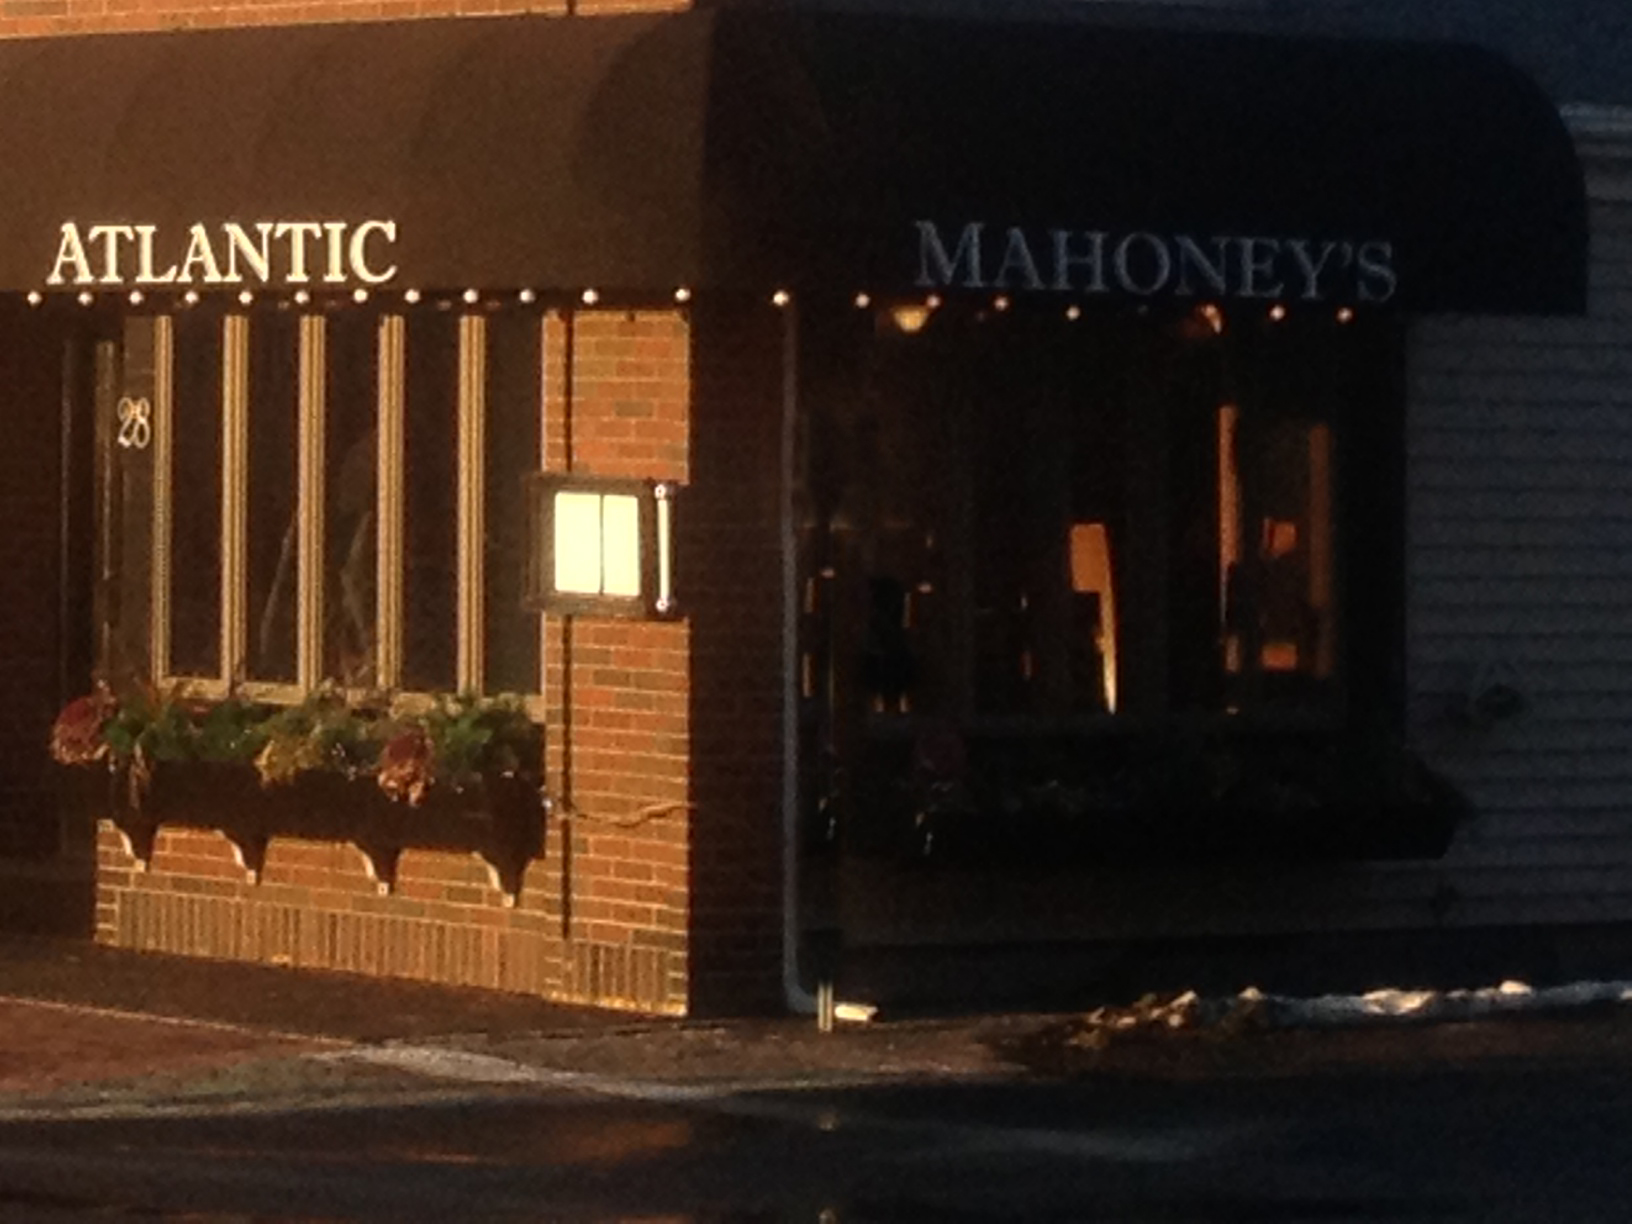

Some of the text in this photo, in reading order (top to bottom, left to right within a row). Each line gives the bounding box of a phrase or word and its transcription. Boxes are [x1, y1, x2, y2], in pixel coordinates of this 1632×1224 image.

[46, 221, 398, 285] ATLANTIC
[913, 219, 1399, 304] MAHONEY'S
[117, 397, 151, 449] 28
